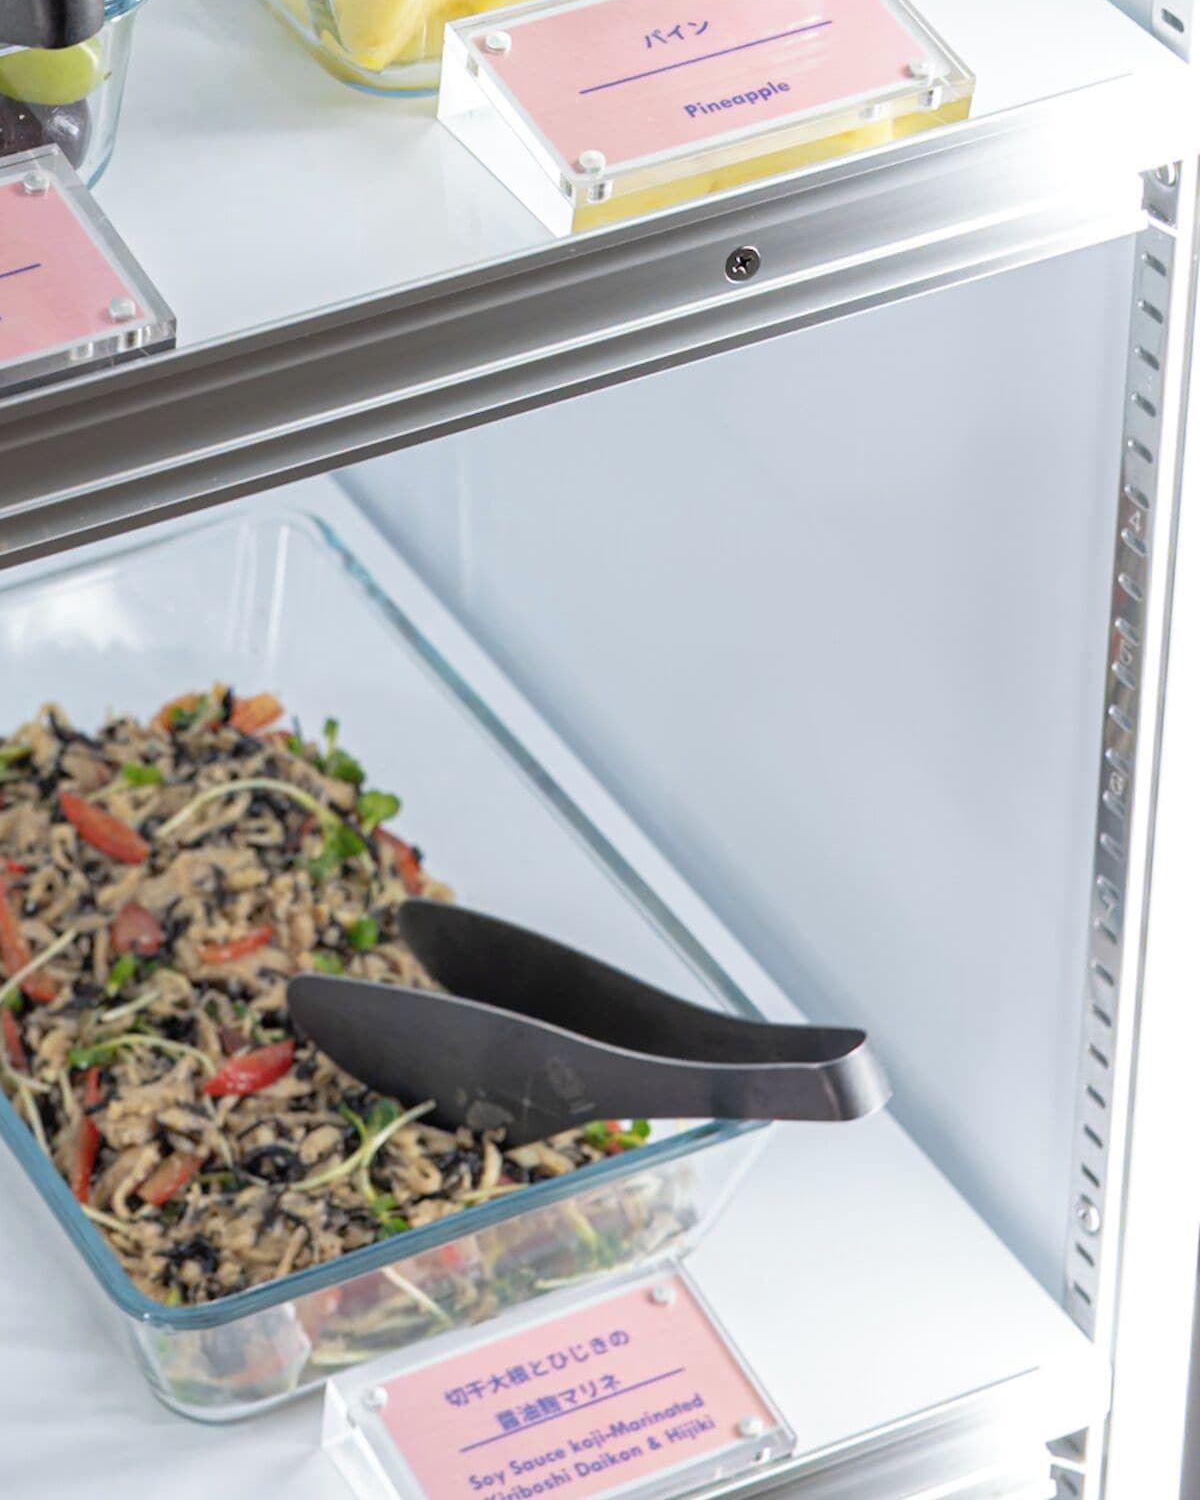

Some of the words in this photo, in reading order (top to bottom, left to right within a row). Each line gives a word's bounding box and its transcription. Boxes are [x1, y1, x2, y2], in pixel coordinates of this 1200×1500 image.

[645, 21, 708, 48] パイン
[683, 81, 791, 118] Pineapple
[445, 1330, 630, 1406] 切干大根とひじきの
[469, 1471, 506, 1490] Soy
[509, 1449, 567, 1476] Sauce
[568, 1393, 705, 1452] koji-Marinated
[574, 1445, 644, 1478] Daikon
[646, 1436, 662, 1451] &
[665, 1414, 716, 1444] Hijiki
